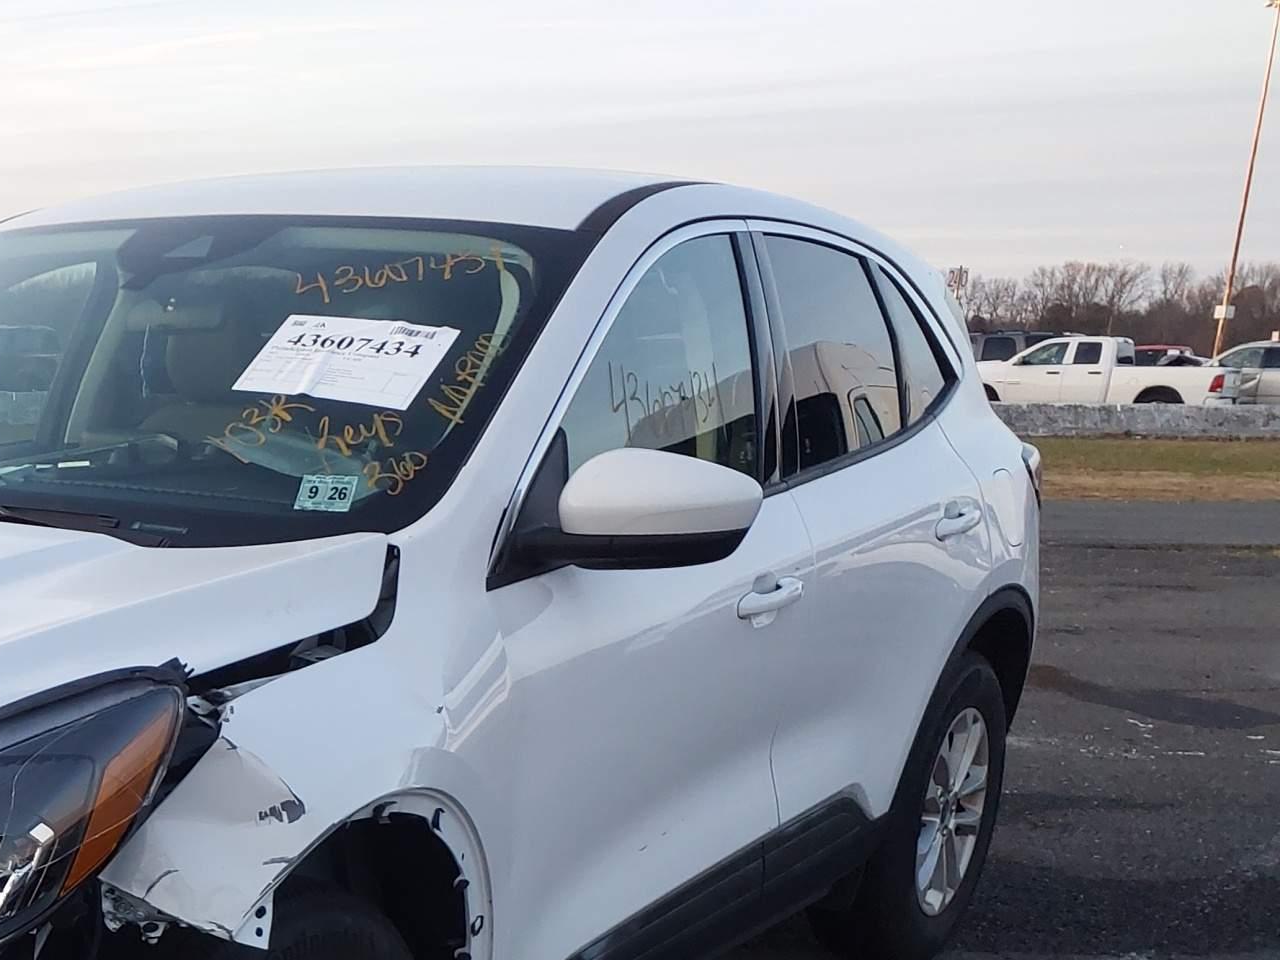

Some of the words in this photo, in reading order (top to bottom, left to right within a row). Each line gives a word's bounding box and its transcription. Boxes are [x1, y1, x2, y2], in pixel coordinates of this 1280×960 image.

[287, 332, 424, 359] 43607434
[307, 485, 320, 500] 9
[327, 486, 349, 501] 26
